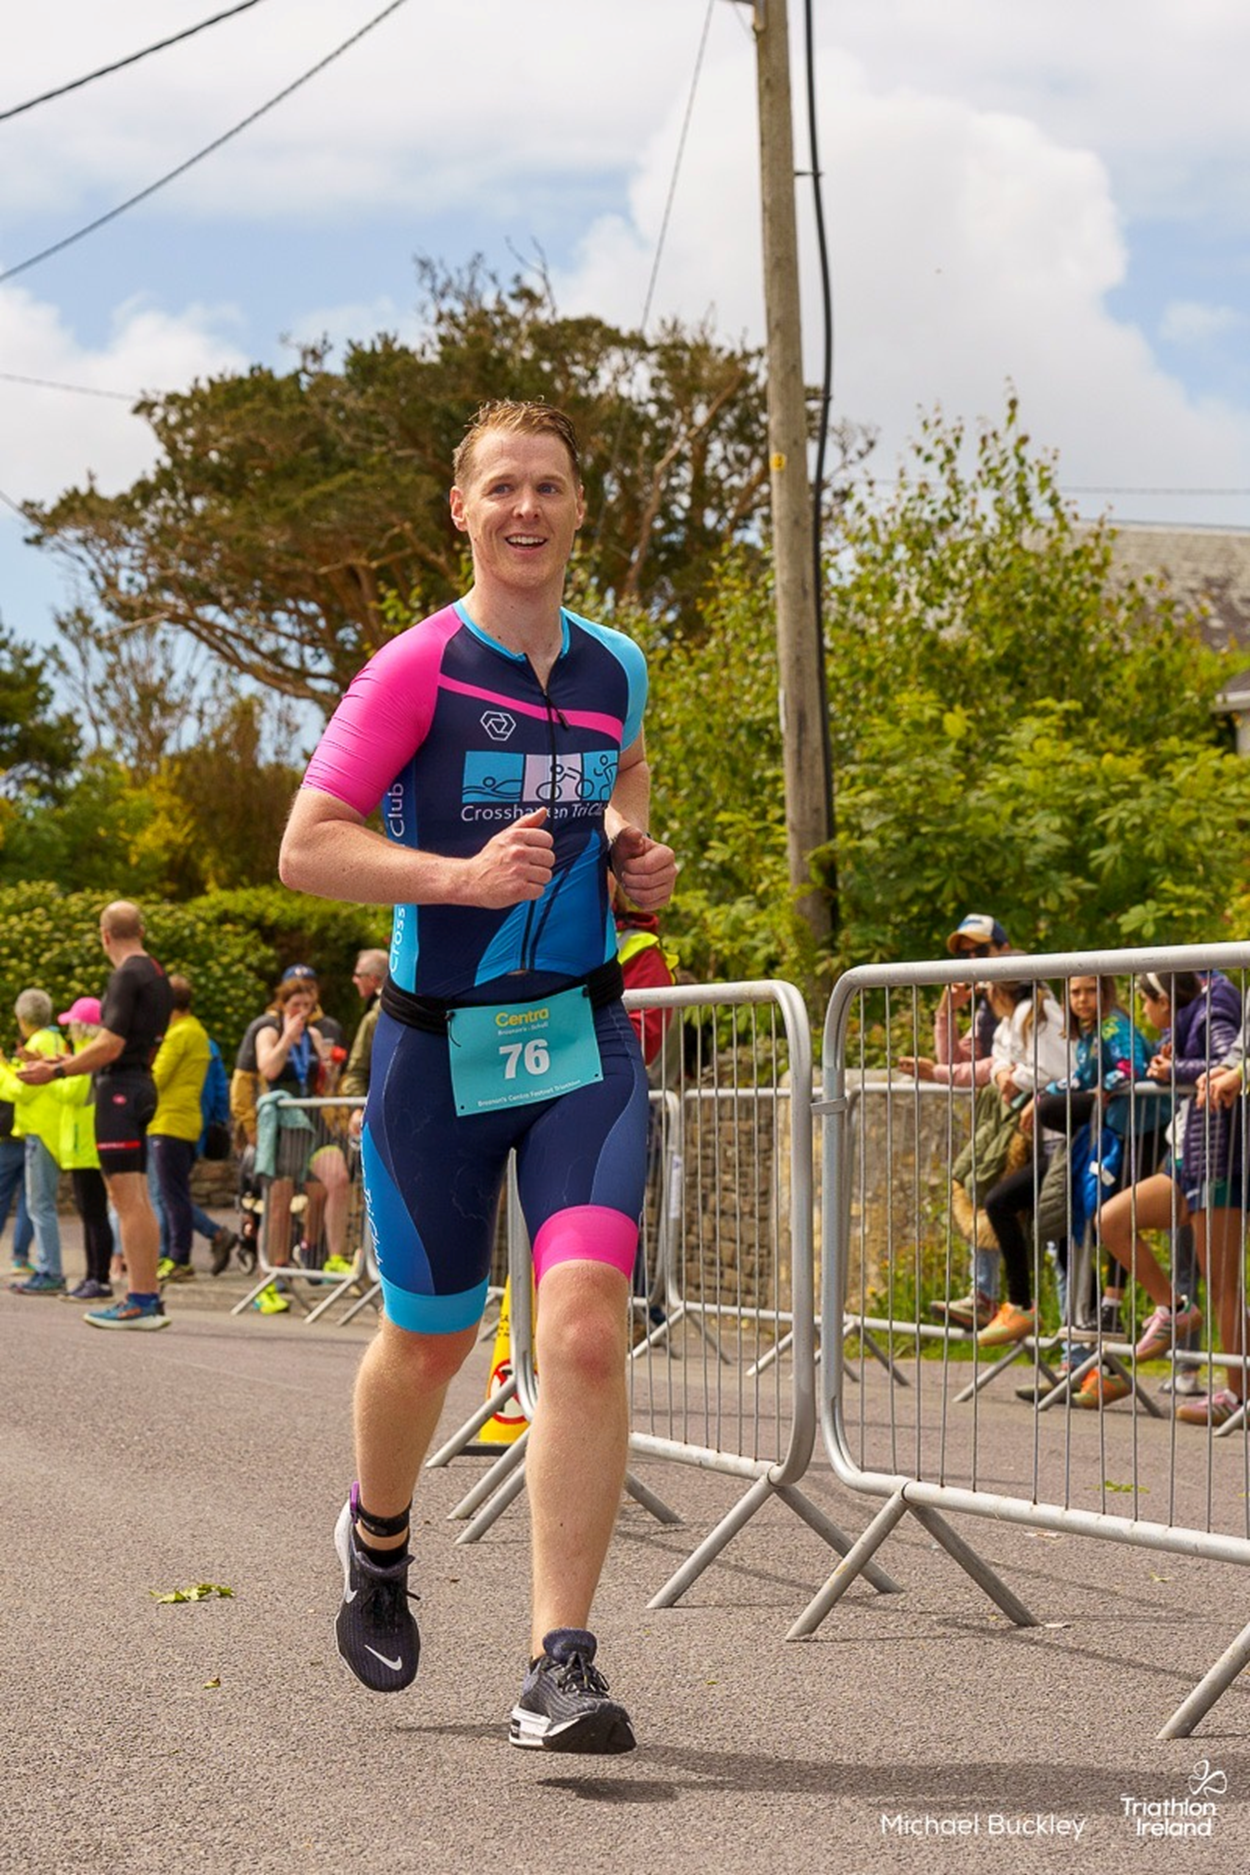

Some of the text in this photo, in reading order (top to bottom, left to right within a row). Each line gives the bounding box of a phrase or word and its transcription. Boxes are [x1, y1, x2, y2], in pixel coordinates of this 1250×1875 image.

[387, 783, 405, 837] Club
[460, 803, 568, 822] Crosshaen
[495, 1008, 549, 1027] Centra
[499, 1039, 549, 1079] 76
